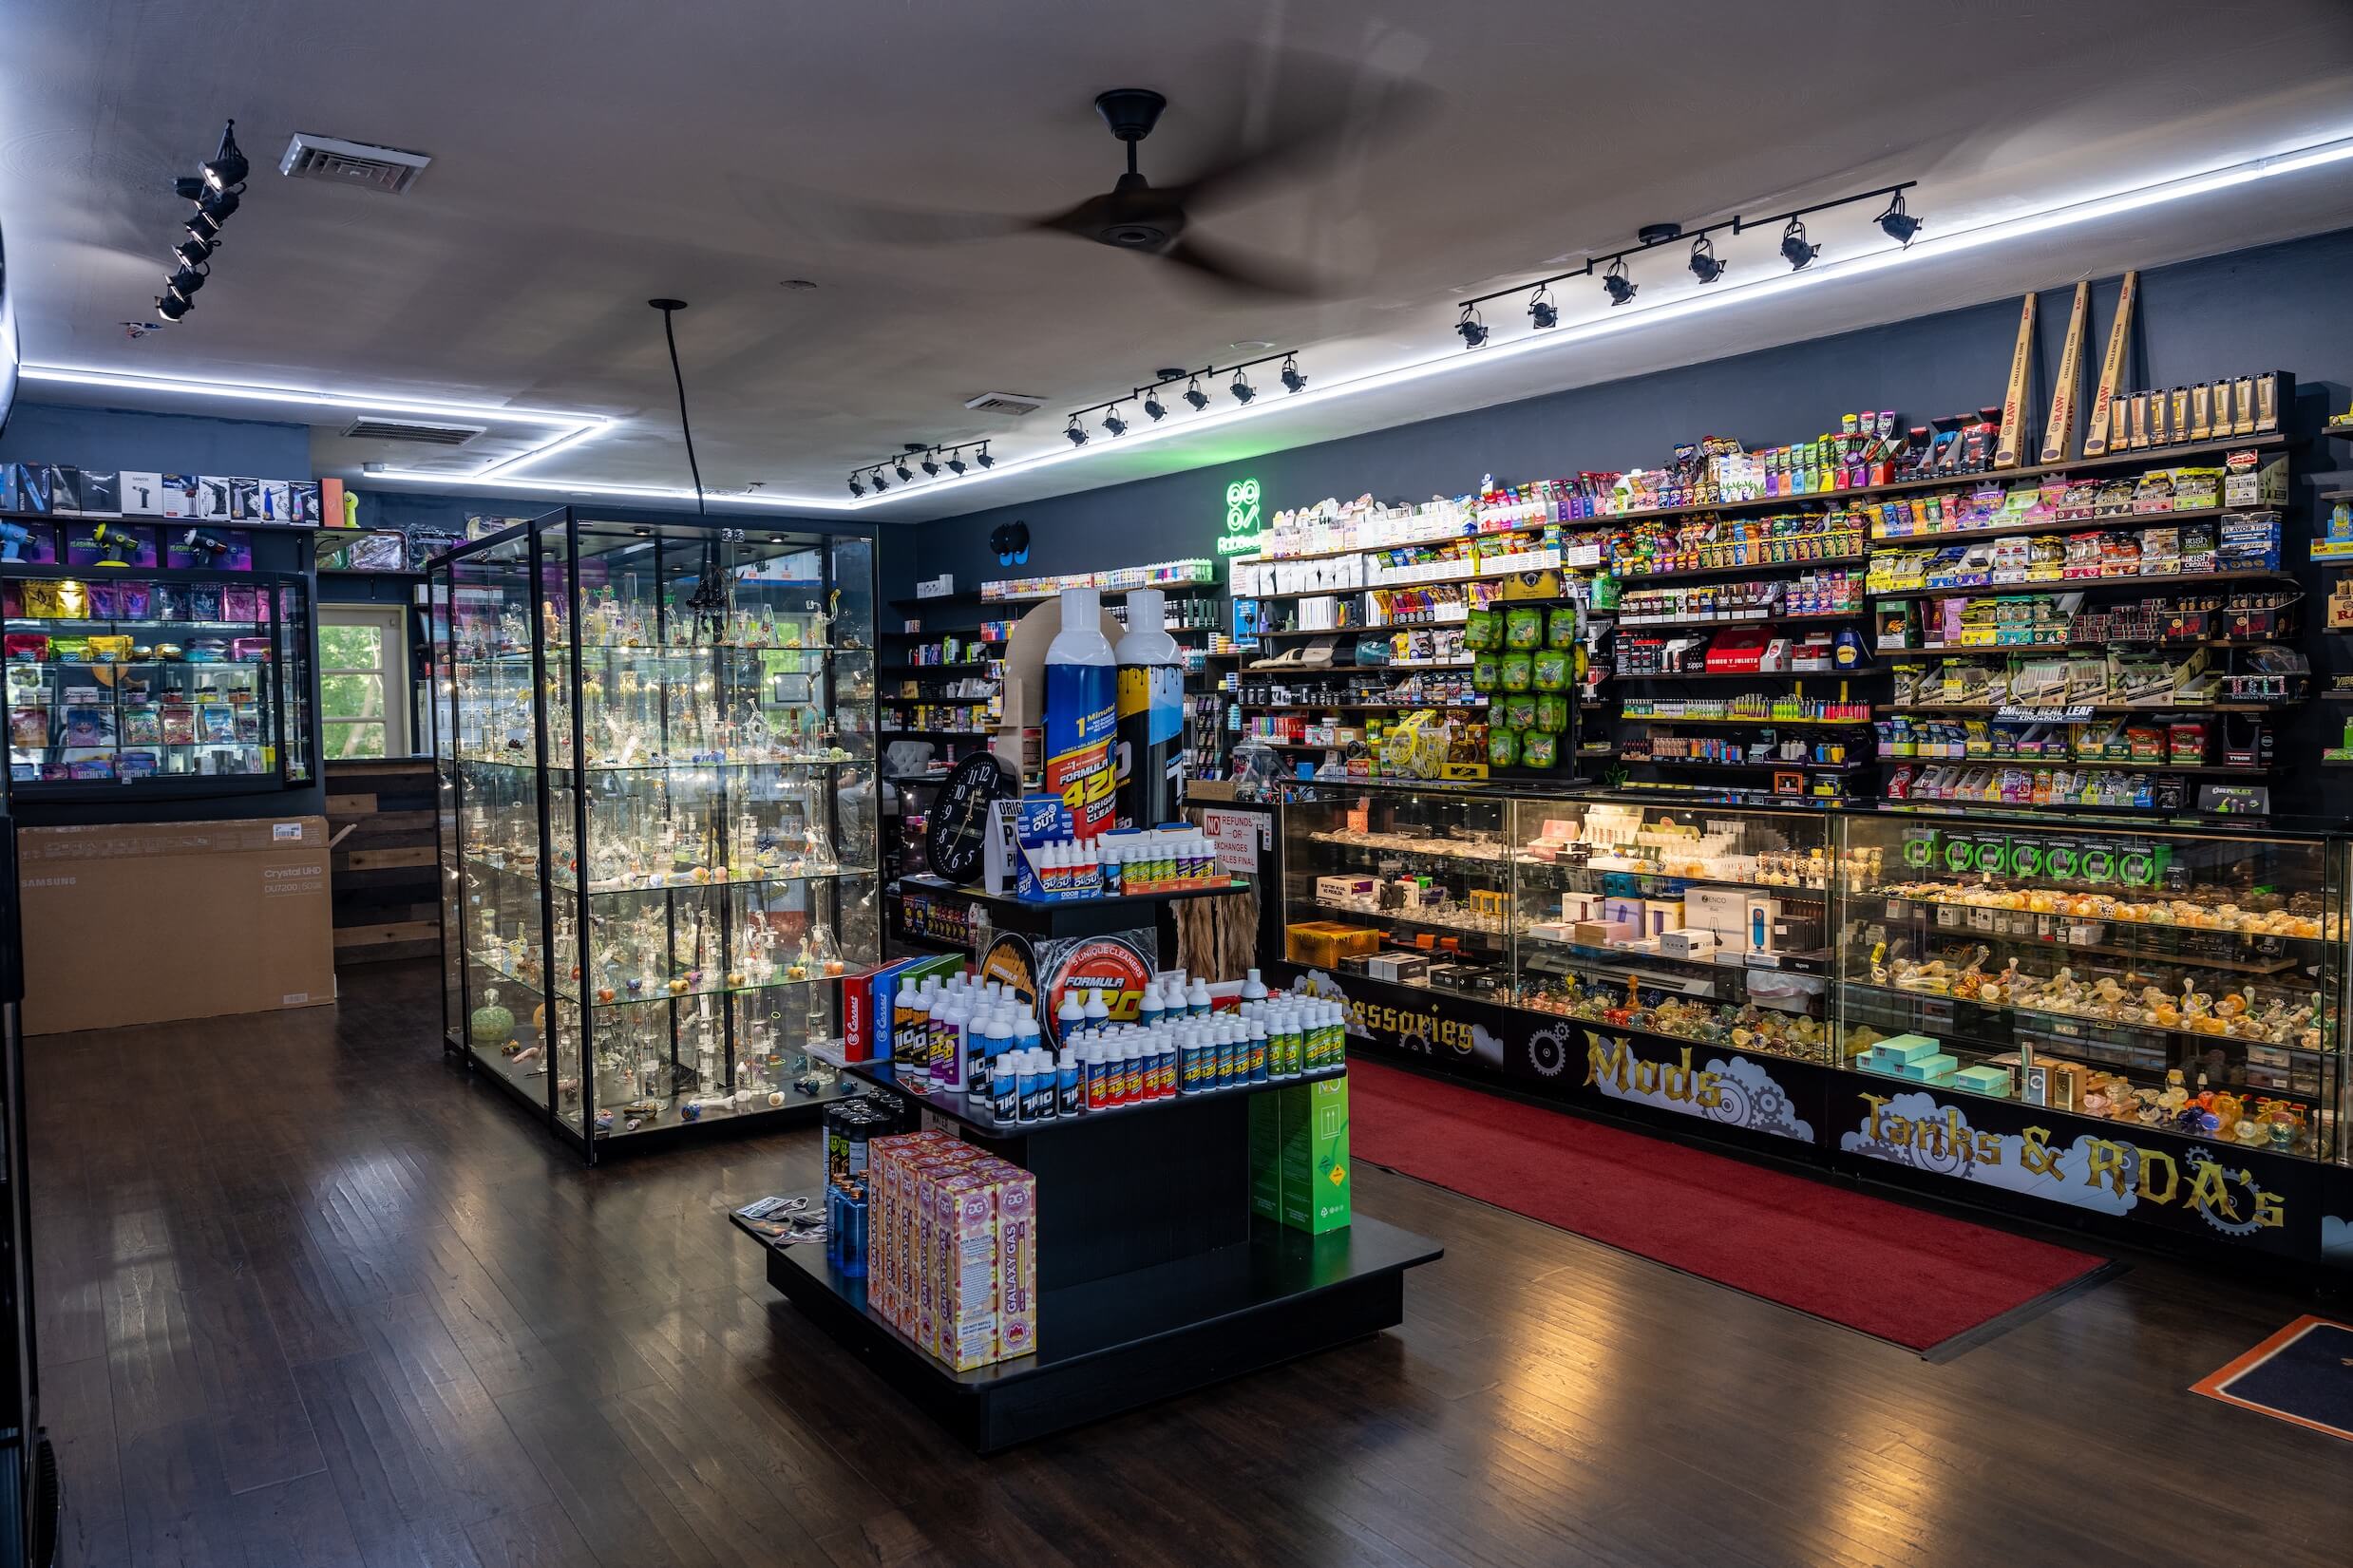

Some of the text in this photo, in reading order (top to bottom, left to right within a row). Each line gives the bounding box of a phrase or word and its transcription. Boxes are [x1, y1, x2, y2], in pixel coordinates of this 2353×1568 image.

[2098, 386, 2109, 413] RAW
[2006, 401, 2016, 426] RAW
[2055, 396, 2064, 422] RAW
[2185, 536, 2208, 545] IRISH
[2185, 551, 2210, 562] IRISH
[1687, 662, 1704, 671] zippo
[1998, 706, 2094, 716] SMOKE REAL LEAF
[1075, 717, 1085, 738] 1
[967, 769, 978, 784] 11
[978, 765, 990, 782] 12
[1060, 758, 1109, 785] FORMULA
[991, 773, 997, 788] 1
[954, 784, 965, 800] 10
[942, 805, 952, 821] 9
[1034, 813, 1056, 832] OUT
[1207, 816, 1252, 836] NO REFUNDS
[939, 828, 948, 843] 8
[1232, 830, 1243, 839] OR
[952, 853, 959, 868] 6
[965, 849, 975, 866] 5
[1238, 857, 1255, 866] FINAL
[264, 866, 321, 879] Crystal UHD
[1702, 895, 1727, 904] ZENCO
[1072, 946, 1143, 978] 5 UNIQUE CLEANERS
[990, 963, 1018, 982] FORMULA
[1064, 976, 1125, 988] FORMULA
[847, 995, 859, 1032] Connect
[876, 992, 887, 1030] Connect
[1583, 1029, 1723, 1110] Mods
[996, 1092, 1015, 1111] 710
[1857, 1093, 2286, 1229] Tanks & RDA's
[1007, 1225, 1016, 1313] GALAXY GAS
